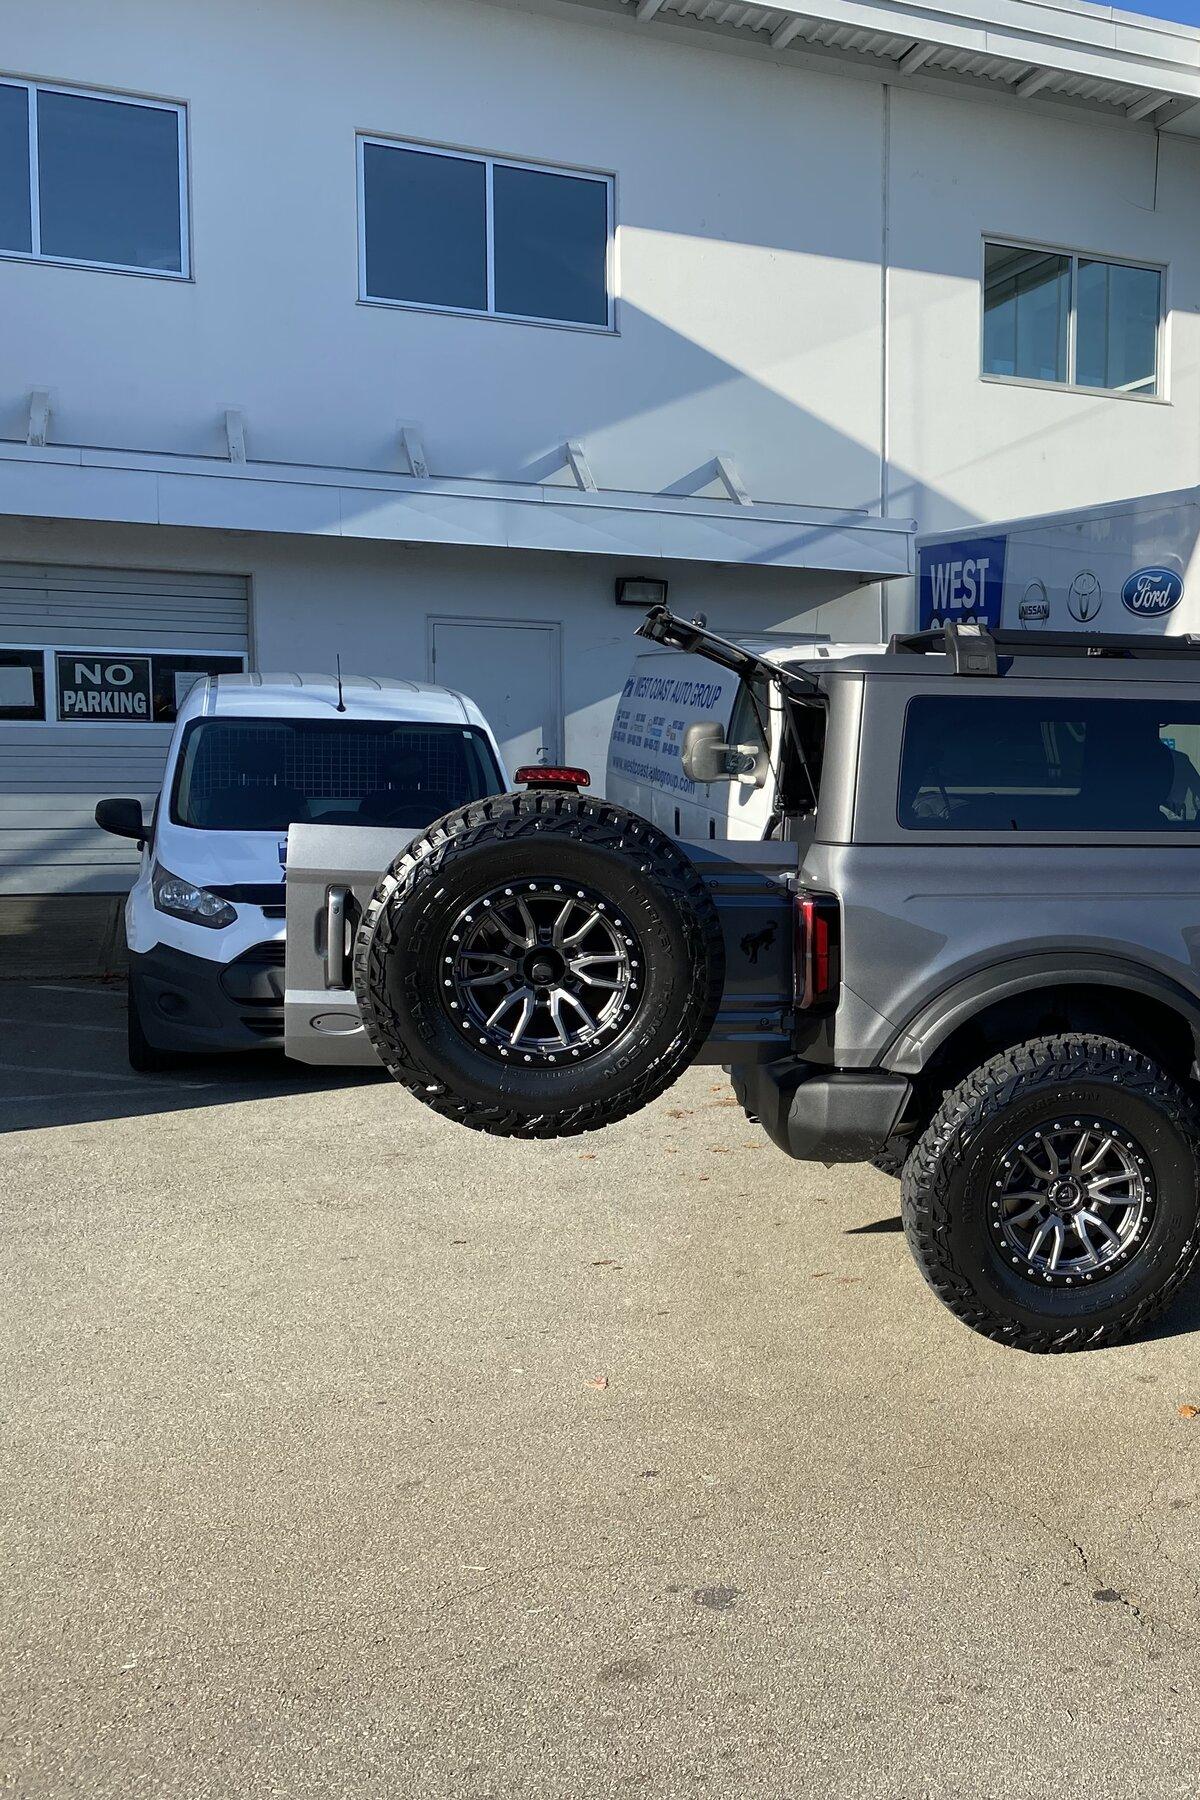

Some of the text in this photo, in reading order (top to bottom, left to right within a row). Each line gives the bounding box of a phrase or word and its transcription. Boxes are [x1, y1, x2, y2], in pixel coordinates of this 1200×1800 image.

[930, 558, 989, 610] WEST
[1133, 575, 1172, 608] Ford
[1020, 604, 1048, 616] NISSAN
[74, 663, 134, 686] NO
[63, 690, 147, 714] PARKING
[633, 676, 722, 710] WEST COAST AUTO GROUP
